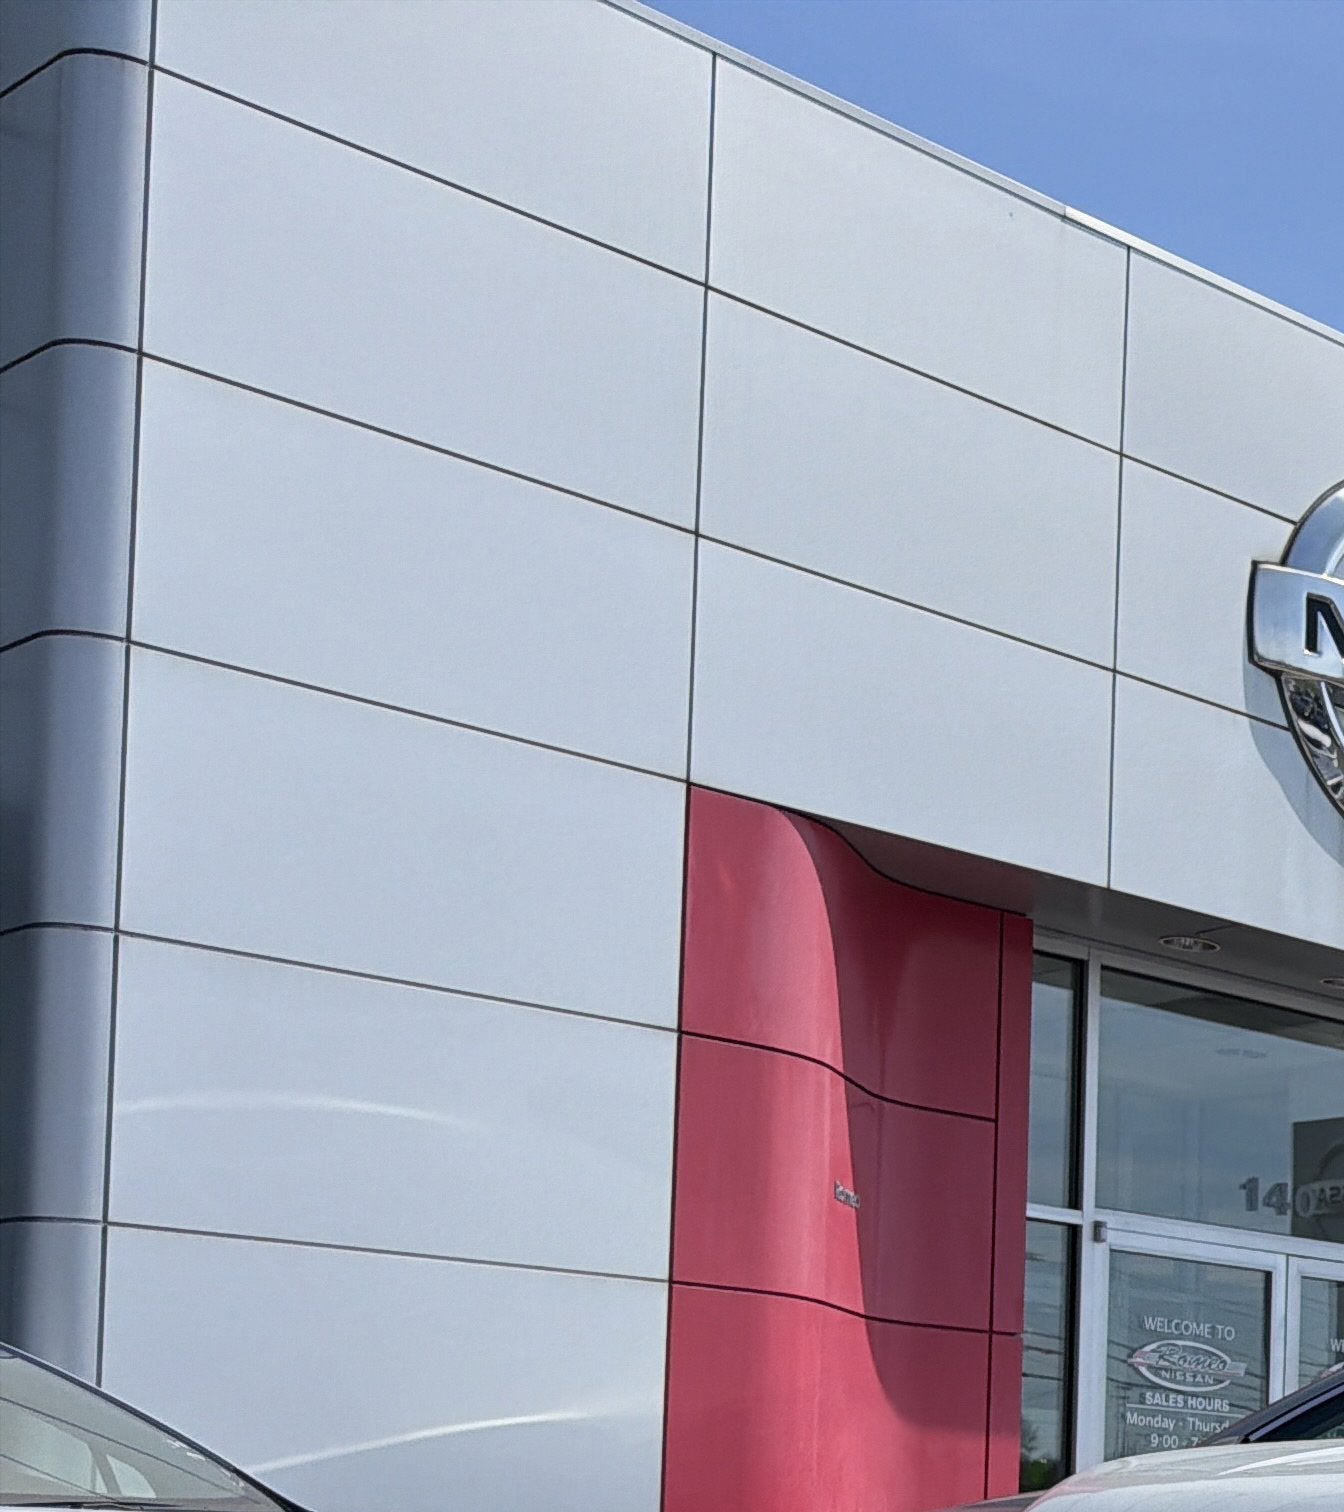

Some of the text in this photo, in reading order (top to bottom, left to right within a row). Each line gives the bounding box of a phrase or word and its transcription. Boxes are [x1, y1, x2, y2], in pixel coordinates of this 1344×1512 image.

[1239, 1176, 1315, 1218] 140
[1144, 1315, 1235, 1341] WELCOME TO
[1152, 1343, 1228, 1372] Romeo
[1161, 1369, 1214, 1384] NISSAN
[1145, 1392, 1230, 1412] SALES HOURS
[1126, 1411, 1176, 1431] Monday
[1187, 1417, 1230, 1433] Thursd
[1151, 1433, 1179, 1448] 9:00
